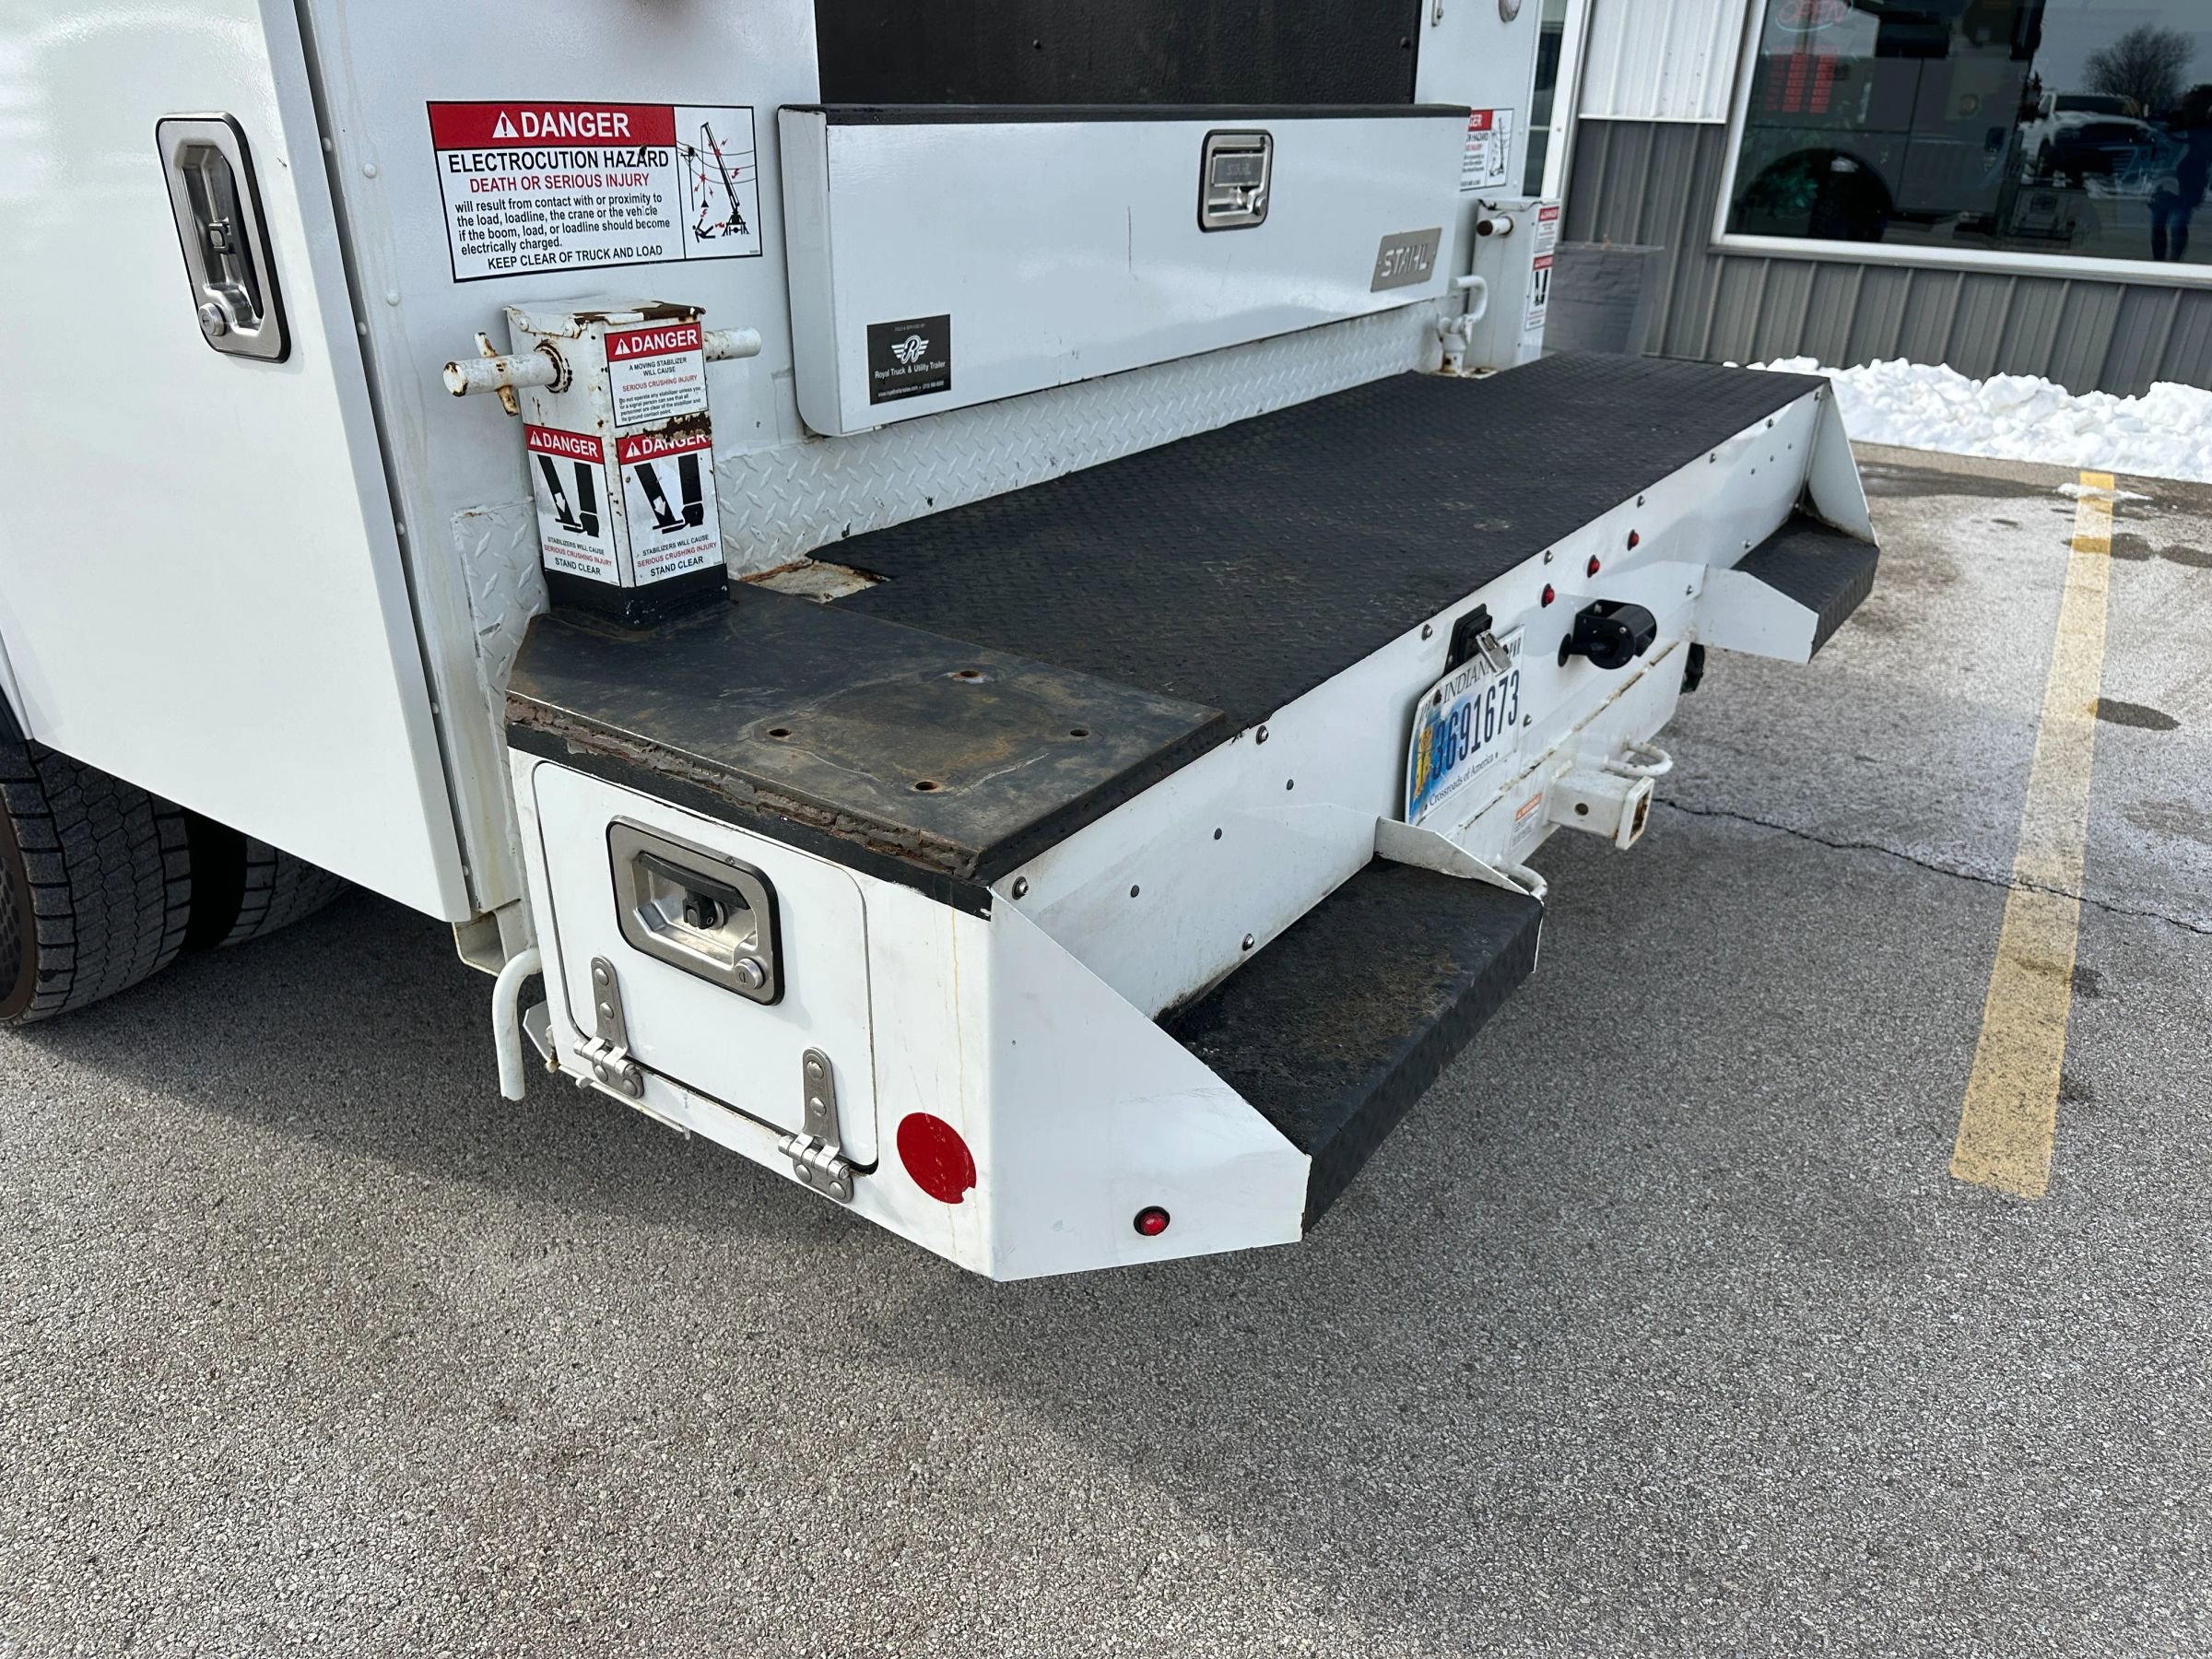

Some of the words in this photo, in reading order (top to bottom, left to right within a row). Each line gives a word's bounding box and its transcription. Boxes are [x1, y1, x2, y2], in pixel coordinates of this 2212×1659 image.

[522, 111, 630, 138] DANGER
[449, 150, 598, 173] ELECTROCUTION
[604, 150, 669, 170] HAZARD
[470, 176, 516, 193] DEATH
[521, 176, 542, 191] OR
[545, 174, 602, 190] SERIOUS
[606, 173, 650, 187] INJURY
[455, 201, 473, 214] will
[476, 200, 507, 212] result
[508, 198, 533, 211] from
[535, 196, 571, 209] contact
[573, 194, 594, 206] with
[595, 196, 606, 206] or
[608, 193, 651, 208] proximity
[653, 194, 662, 203] to
[457, 216, 474, 228] the
[477, 214, 502, 227] load,
[505, 211, 547, 224] loadline,
[549, 210, 566, 221] the
[568, 208, 594, 220] crane
[596, 208, 607, 218] or
[609, 206, 624, 218] the
[626, 205, 658, 217] vehicle
[459, 230, 467, 242] if
[468, 229, 486, 241] the
[488, 227, 521, 240] boom,
[523, 224, 547, 237] load,
[549, 224, 560, 235] or
[562, 221, 600, 234] loadline
[602, 219, 634, 231] should
[635, 218, 670, 229] become
[461, 239, 517, 255] electrically
[519, 237, 562, 253] charged.
[488, 256, 517, 270] KEEP
[520, 253, 557, 267] CLEAR
[559, 251, 573, 264] OF
[575, 248, 611, 262] TRUCK
[613, 246, 634, 259] AND
[636, 245, 663, 256] LOAD
[1381, 243, 1429, 277] STAHL
[631, 329, 698, 353] DANGER
[634, 361, 656, 370] MOVING
[656, 357, 687, 367] STABILIZER
[875, 369, 890, 380] Royal
[890, 367, 906, 376] Truck
[913, 363, 930, 372] Utility
[930, 360, 946, 370] Trailer
[622, 383, 647, 392] SERIOUS
[648, 378, 677, 388] CRUSHING
[678, 374, 698, 382] INJURY
[542, 429, 598, 458] DANGER
[642, 434, 707, 454] DANGER
[544, 545, 566, 556] SERIOUS
[566, 549, 593, 562] CRUSHING
[594, 556, 612, 567] INJURY
[547, 536, 576, 550] STABILIZERS
[577, 543, 588, 552] WILL
[588, 546, 605, 556] CAUSE
[637, 555, 664, 568] SERIOUS
[665, 548, 696, 562] CRUSHING
[696, 542, 717, 555] INJURY
[642, 542, 676, 557] STABILIZERS
[677, 539, 689, 548] WILL
[690, 535, 709, 546] CAUSE
[555, 558, 577, 571] STAND
[578, 563, 601, 576] CLEAR
[650, 563, 676, 577] STAND
[677, 556, 703, 571] CLEAR
[1433, 669, 1519, 778] 3691673
[1429, 772, 1463, 806] Crossroads
[1463, 769, 1471, 782] of
[1471, 755, 1494, 777] America
